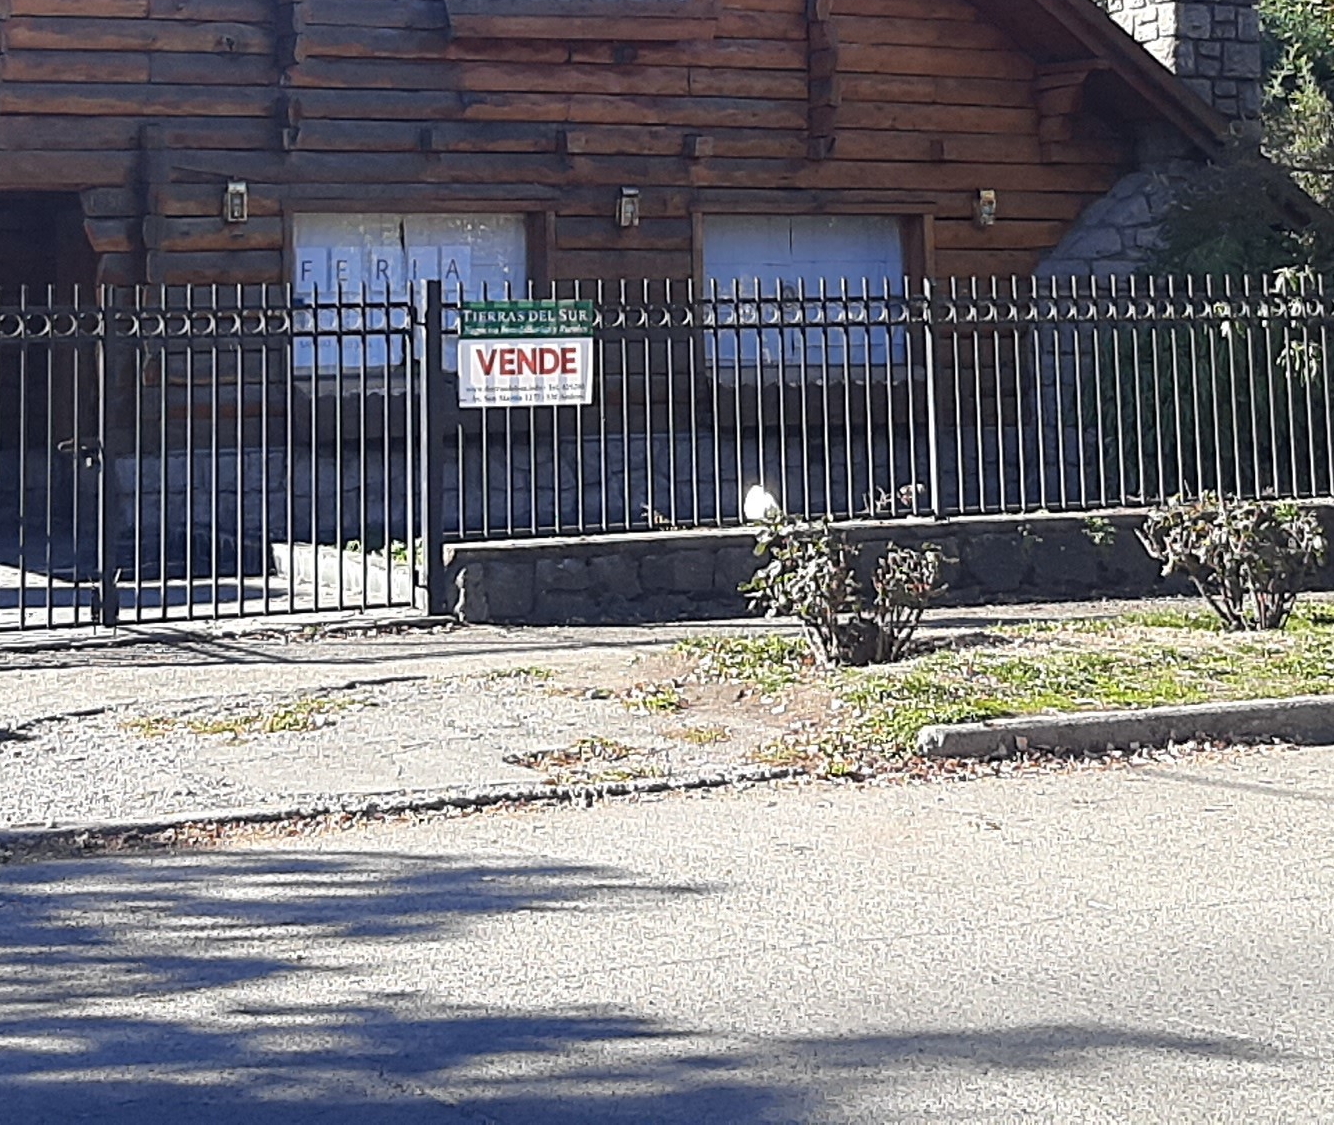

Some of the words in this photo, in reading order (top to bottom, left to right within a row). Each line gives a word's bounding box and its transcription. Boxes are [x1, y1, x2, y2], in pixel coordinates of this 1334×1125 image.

[301, 259, 460, 282] FERIA
[463, 310, 525, 322] TIERRAS
[528, 310, 556, 322] DEL
[558, 309, 588, 322] SUR
[476, 347, 578, 376] VENDE
